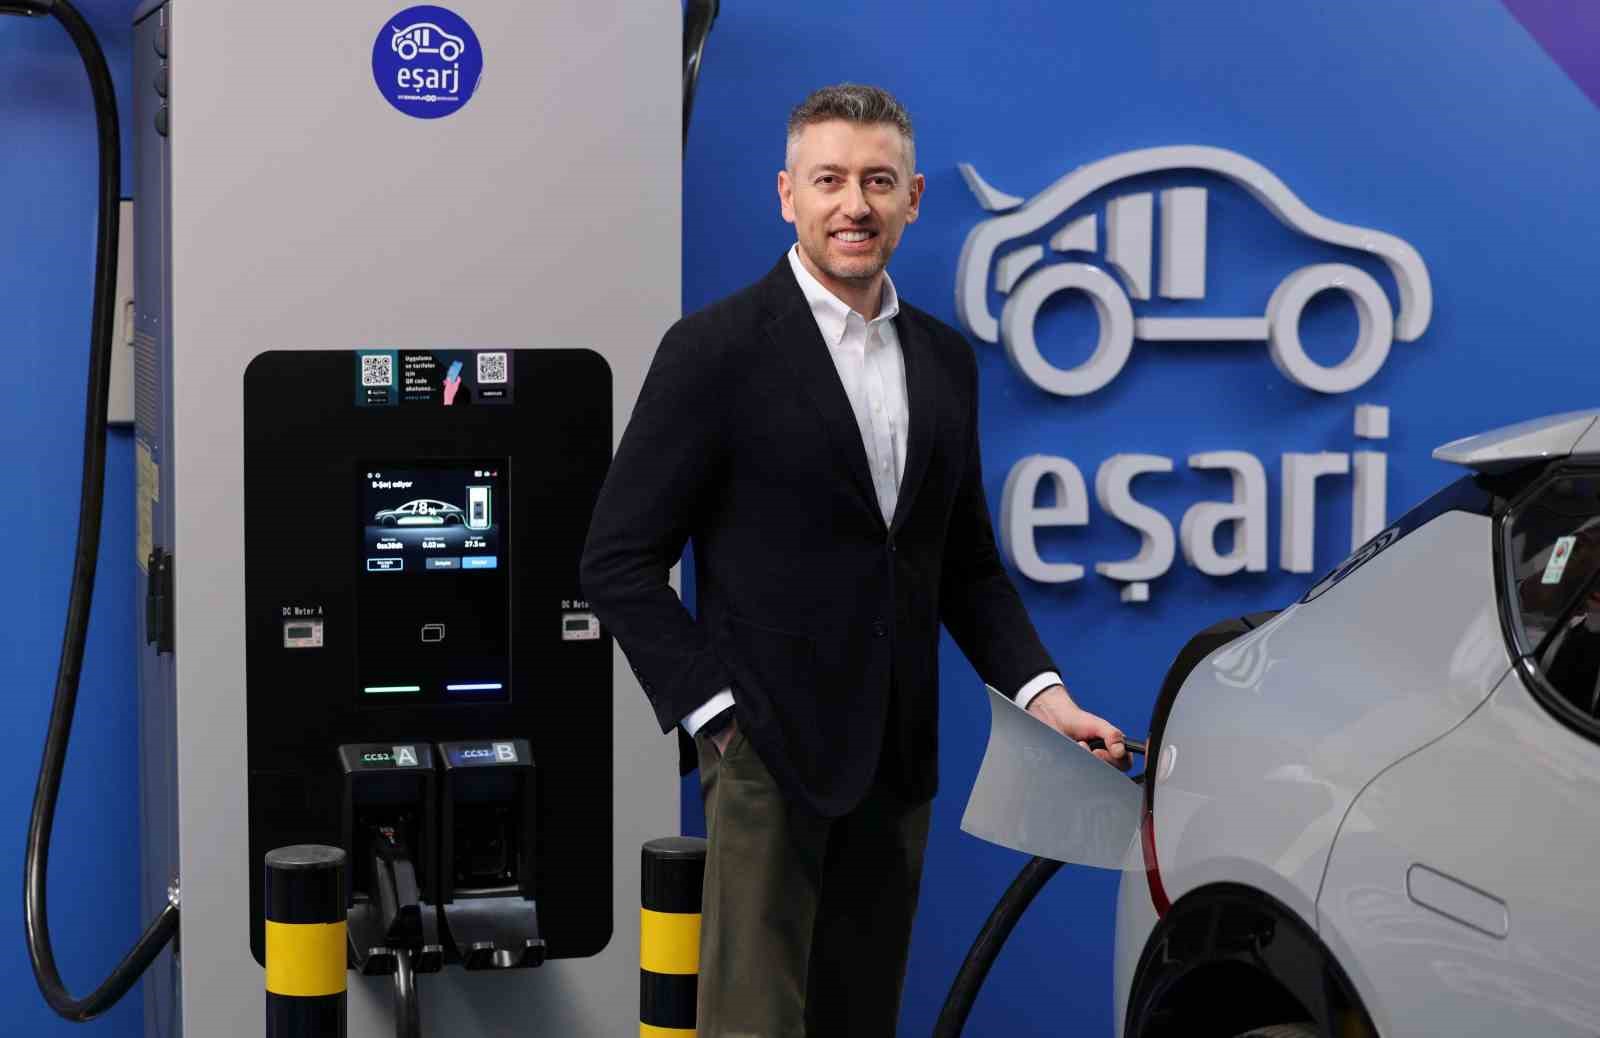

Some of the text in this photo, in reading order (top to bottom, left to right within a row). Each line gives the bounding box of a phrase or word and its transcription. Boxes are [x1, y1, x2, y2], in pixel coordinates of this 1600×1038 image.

[397, 62, 459, 93] eşarj
[282, 605, 323, 616] DC Meter A
[561, 600, 570, 609] DC
[399, 748, 417, 765] A
[498, 744, 514, 760] B
